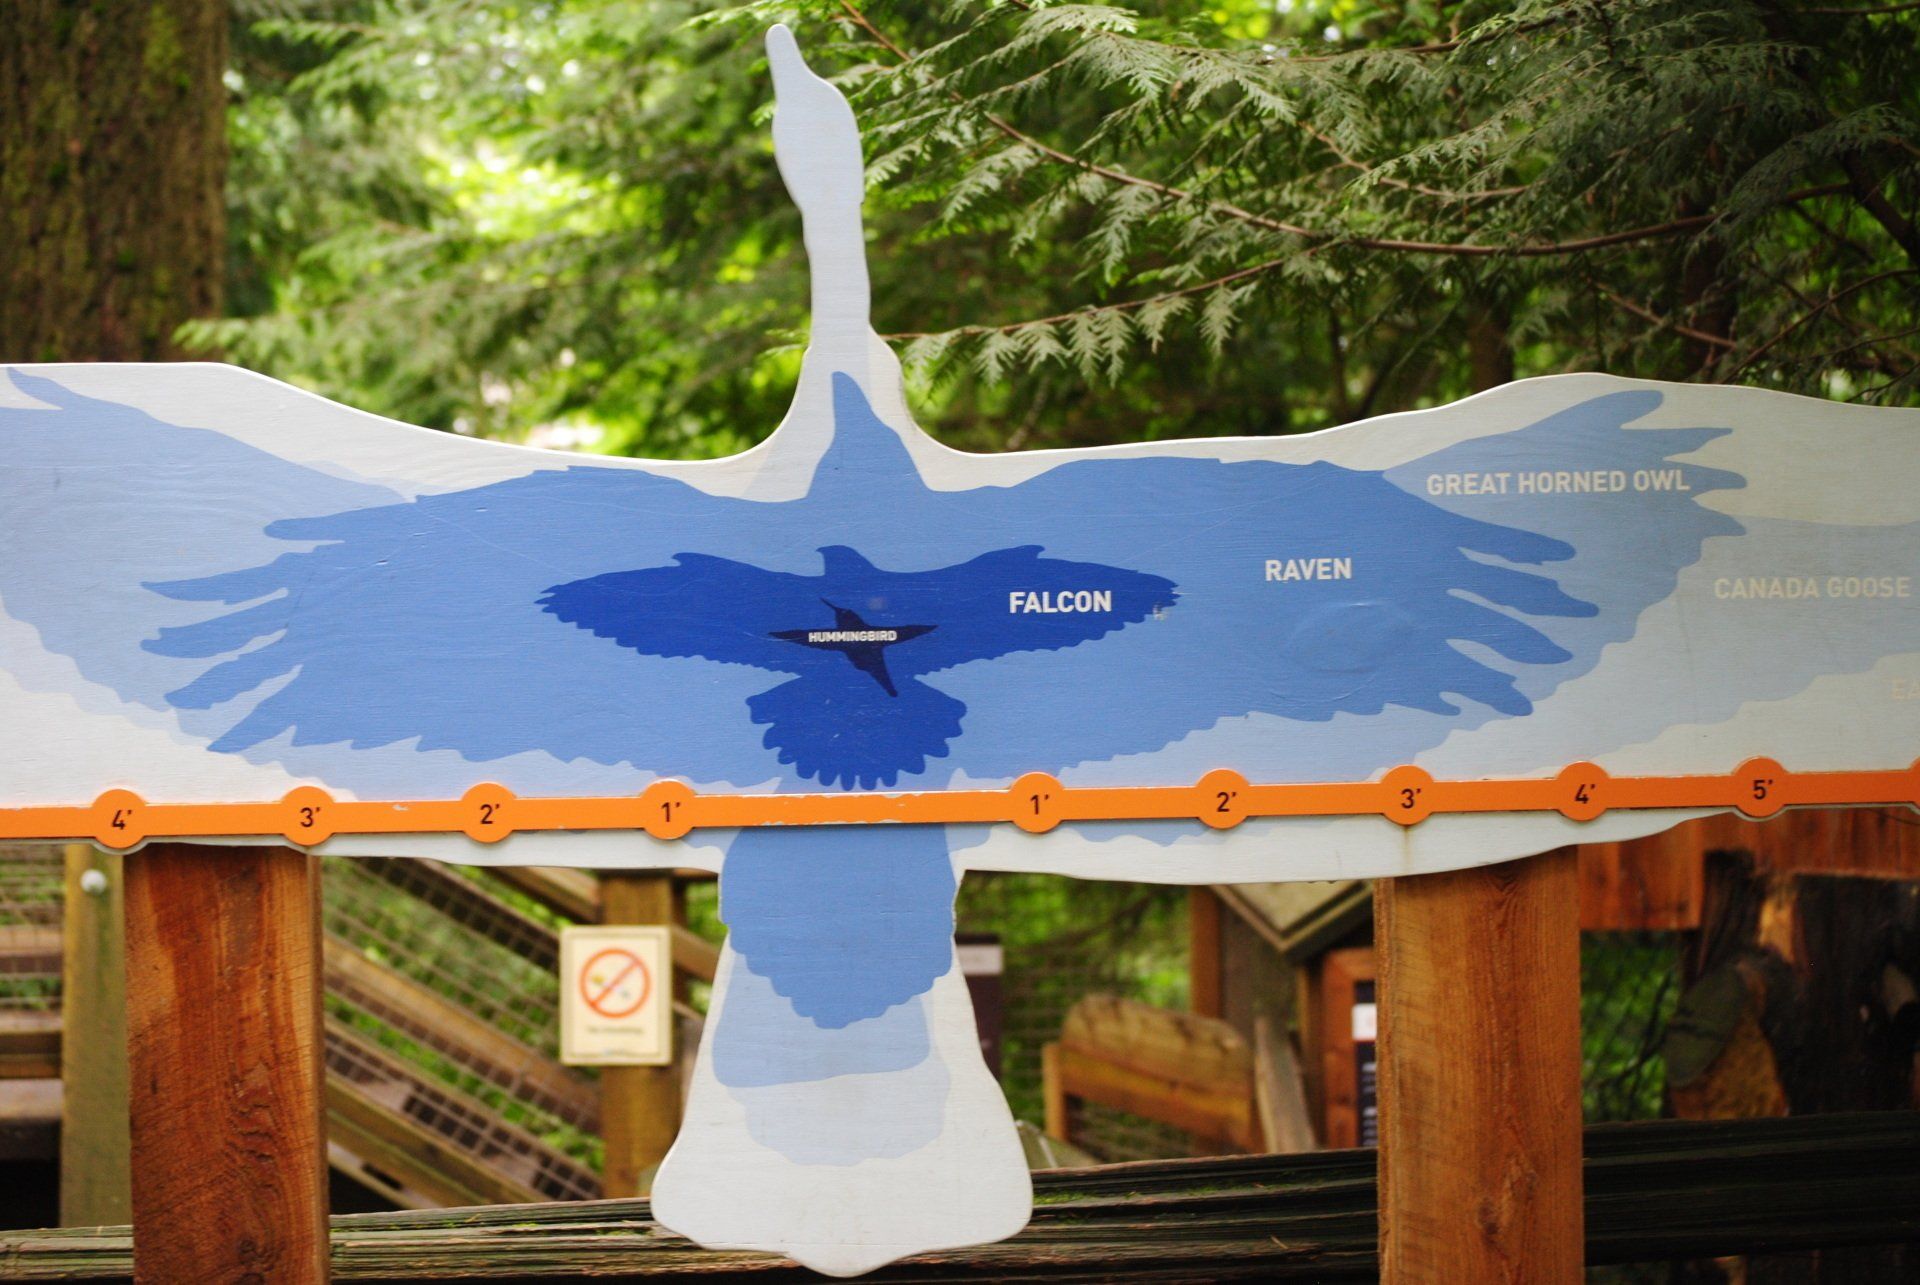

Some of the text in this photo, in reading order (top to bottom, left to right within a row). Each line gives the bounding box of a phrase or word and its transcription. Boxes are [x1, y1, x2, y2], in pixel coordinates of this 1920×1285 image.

[1426, 468, 1691, 496] GREAT HORNED OWL
[1265, 558, 1352, 581] RAVEN
[1714, 576, 1911, 599] CANADA GOOSE
[1009, 590, 1112, 614] FALCON
[808, 630, 898, 643] HUMMINGBIRD
